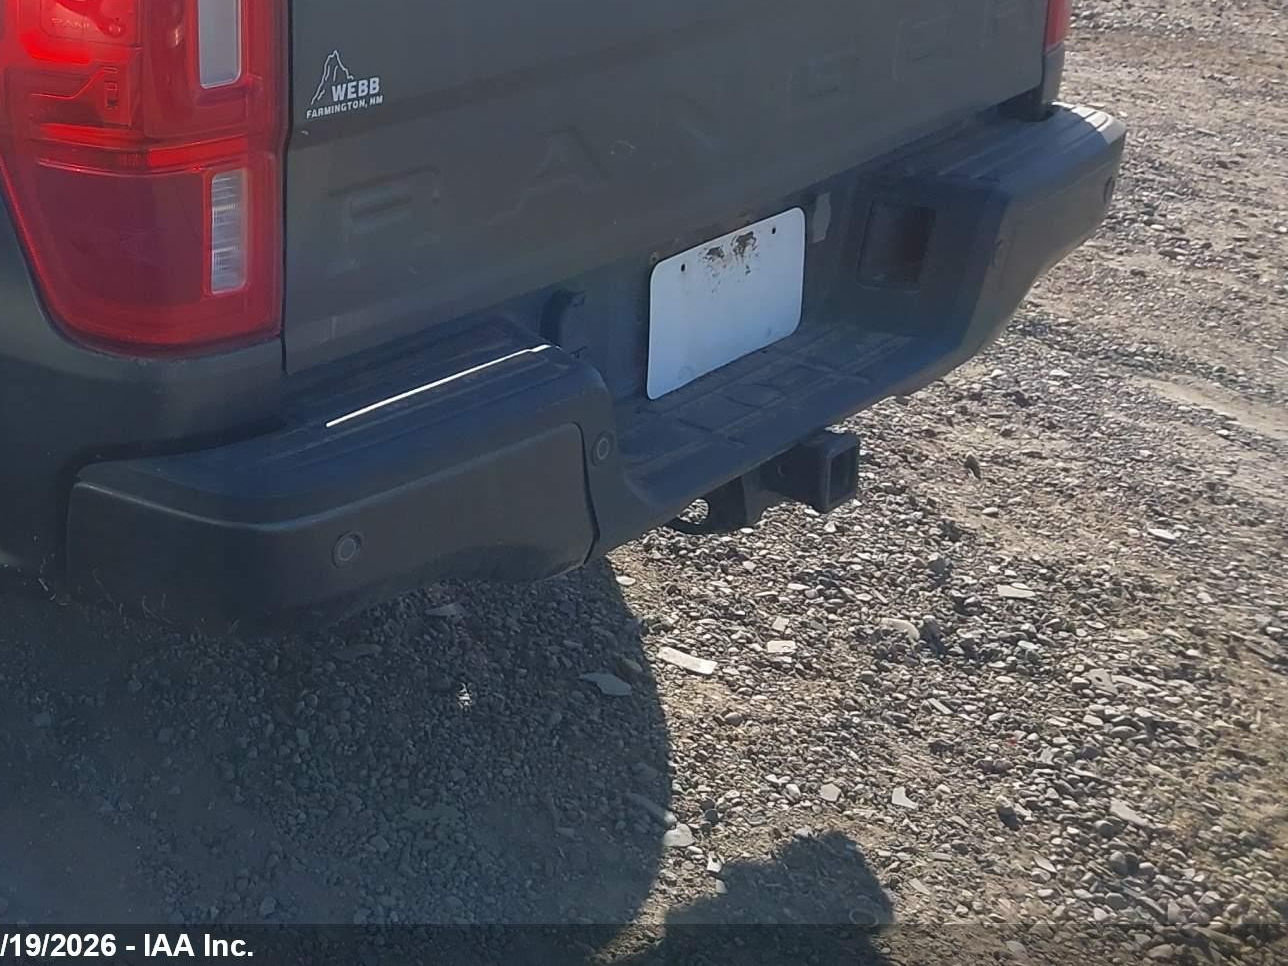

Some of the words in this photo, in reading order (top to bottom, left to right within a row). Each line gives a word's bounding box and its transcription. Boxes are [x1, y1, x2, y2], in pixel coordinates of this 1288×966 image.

[331, 77, 380, 102] WEBB
[305, 98, 368, 120] FARMINGTON,
[369, 95, 384, 106] NM
